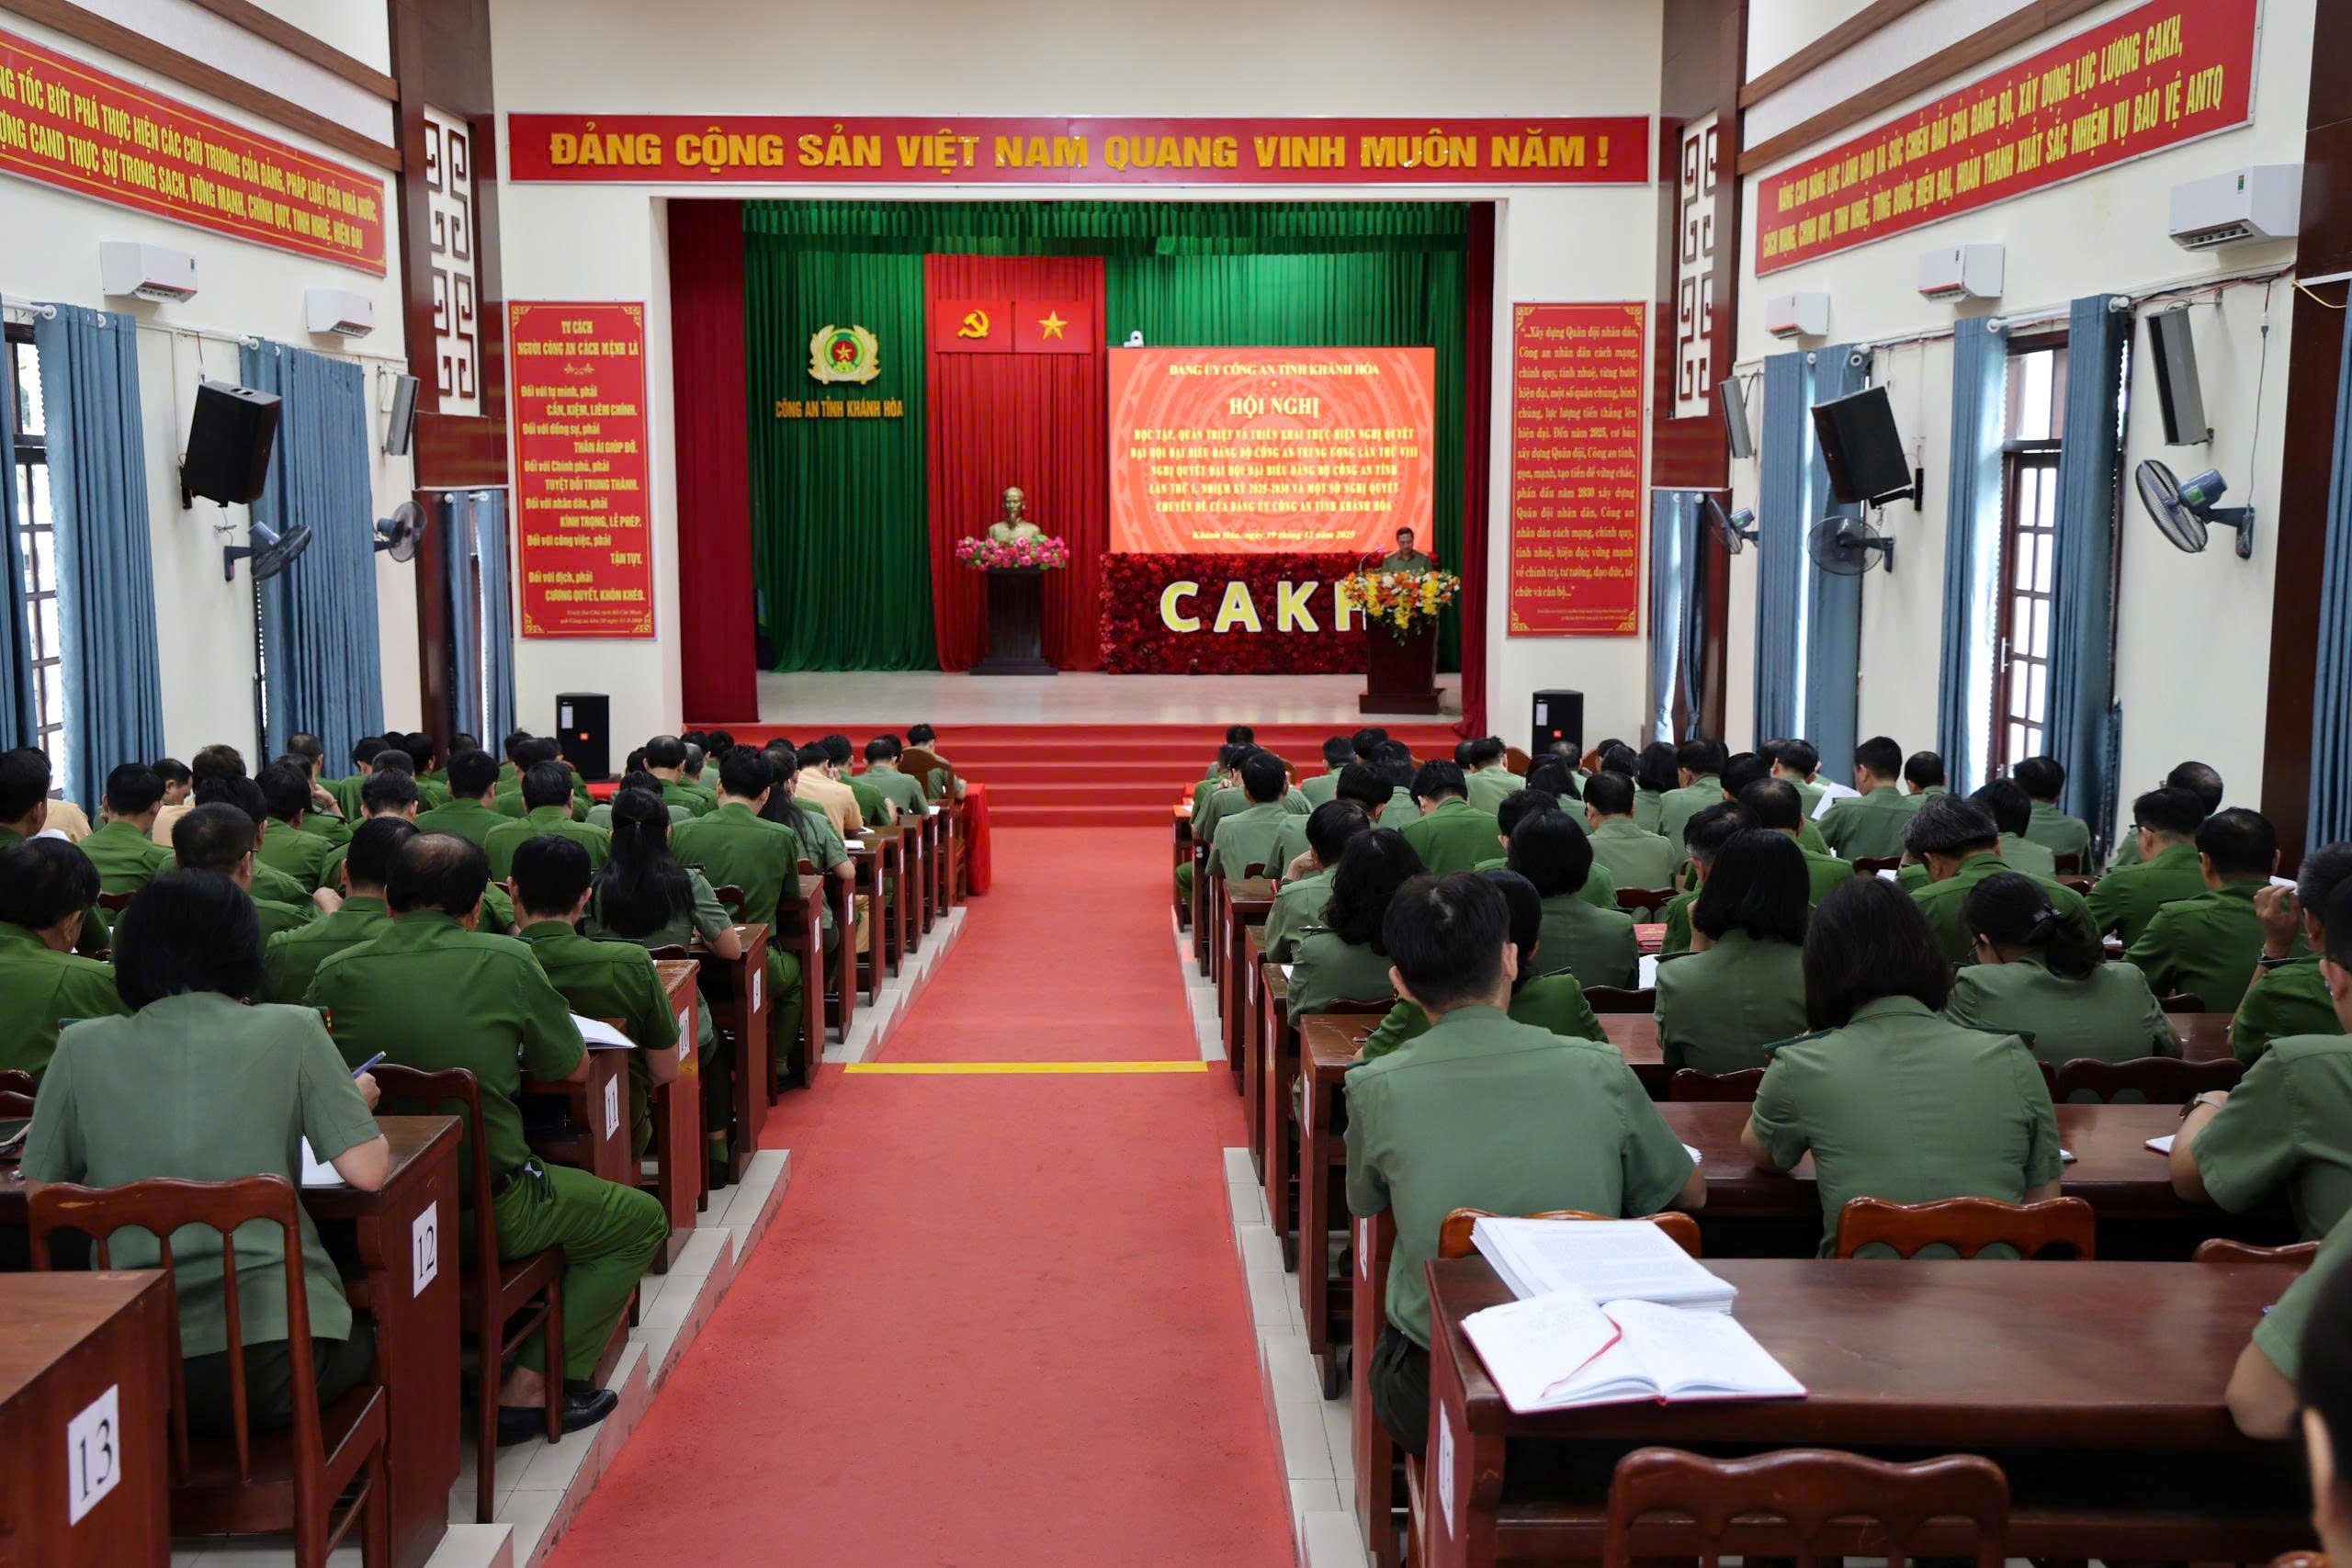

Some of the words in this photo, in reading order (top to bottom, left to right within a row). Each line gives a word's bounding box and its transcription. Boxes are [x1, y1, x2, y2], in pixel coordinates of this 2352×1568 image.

[1971, 89, 1996, 136] ĐẢNG
[1998, 81, 2014, 130] BỘ,
[2018, 72, 2039, 118] XÂY
[2041, 62, 2071, 112] DỰNG
[2075, 50, 2097, 99] LỰC
[2100, 33, 2141, 86] LƯỢNG
[2144, 14, 2182, 65] CAKH,
[17, 66, 44, 109] TỐC
[47, 82, 70, 120] BỨT
[74, 95, 99, 130] PHÁ
[101, 104, 130, 145] THỰC
[133, 115, 159, 153] HIỆN
[161, 125, 181, 159] CÁC
[184, 132, 203, 165] CHỦ
[205, 142, 240, 178] TRƯƠNG
[242, 150, 259, 184] CỦA
[260, 156, 286, 196] ĐẢNG,
[287, 171, 307, 199] PHÁP
[308, 177, 325, 209] LUẬT
[550, 121, 662, 166] ĐẢNG
[676, 126, 784, 174] CỘNG
[798, 124, 881, 167] SẢN
[897, 129, 978, 175] VIỆT
[995, 135, 1089, 167] NAM
[1104, 136, 1238, 171] QUANG
[1255, 136, 1345, 167] VINH
[1361, 128, 1477, 167] MUÔN
[1491, 128, 1584, 167] NĂM
[1597, 136, 1609, 167] !
[1956, 148, 1981, 195] HOÀN
[1984, 138, 2014, 185] THÀNH
[2017, 117, 2043, 174] XUẤT
[2046, 107, 2067, 164] SẮC
[2072, 102, 2109, 157] NHIỆM
[2113, 99, 2130, 146] VỤ
[2133, 76, 2159, 133] BẢO
[2165, 70, 2182, 129] VỆ
[2186, 64, 2223, 116] ANTQ
[29, 122, 65, 161] CAND
[68, 135, 99, 175] THỰC
[102, 147, 118, 185] SỰ
[120, 153, 156, 190] TRONG
[159, 165, 188, 203] SẠCH,
[190, 174, 215, 208] VỮNG
[217, 185, 247, 220] MẠNH,
[248, 192, 273, 225] CHÍNH
[775, 397, 802, 418] CÔNG
[805, 400, 820, 418] AN
[820, 395, 843, 418] TỈNH
[847, 397, 881, 418] KHÁNH
[1229, 395, 1264, 419] HỘI
[1271, 397, 1319, 419] NGHỊ
[1160, 581, 1367, 633] CAKH
[681, 1020, 687, 1051] 10
[607, 1090, 616, 1130] 11
[419, 1225, 435, 1280] 12
[79, 1418, 112, 1501] 13
